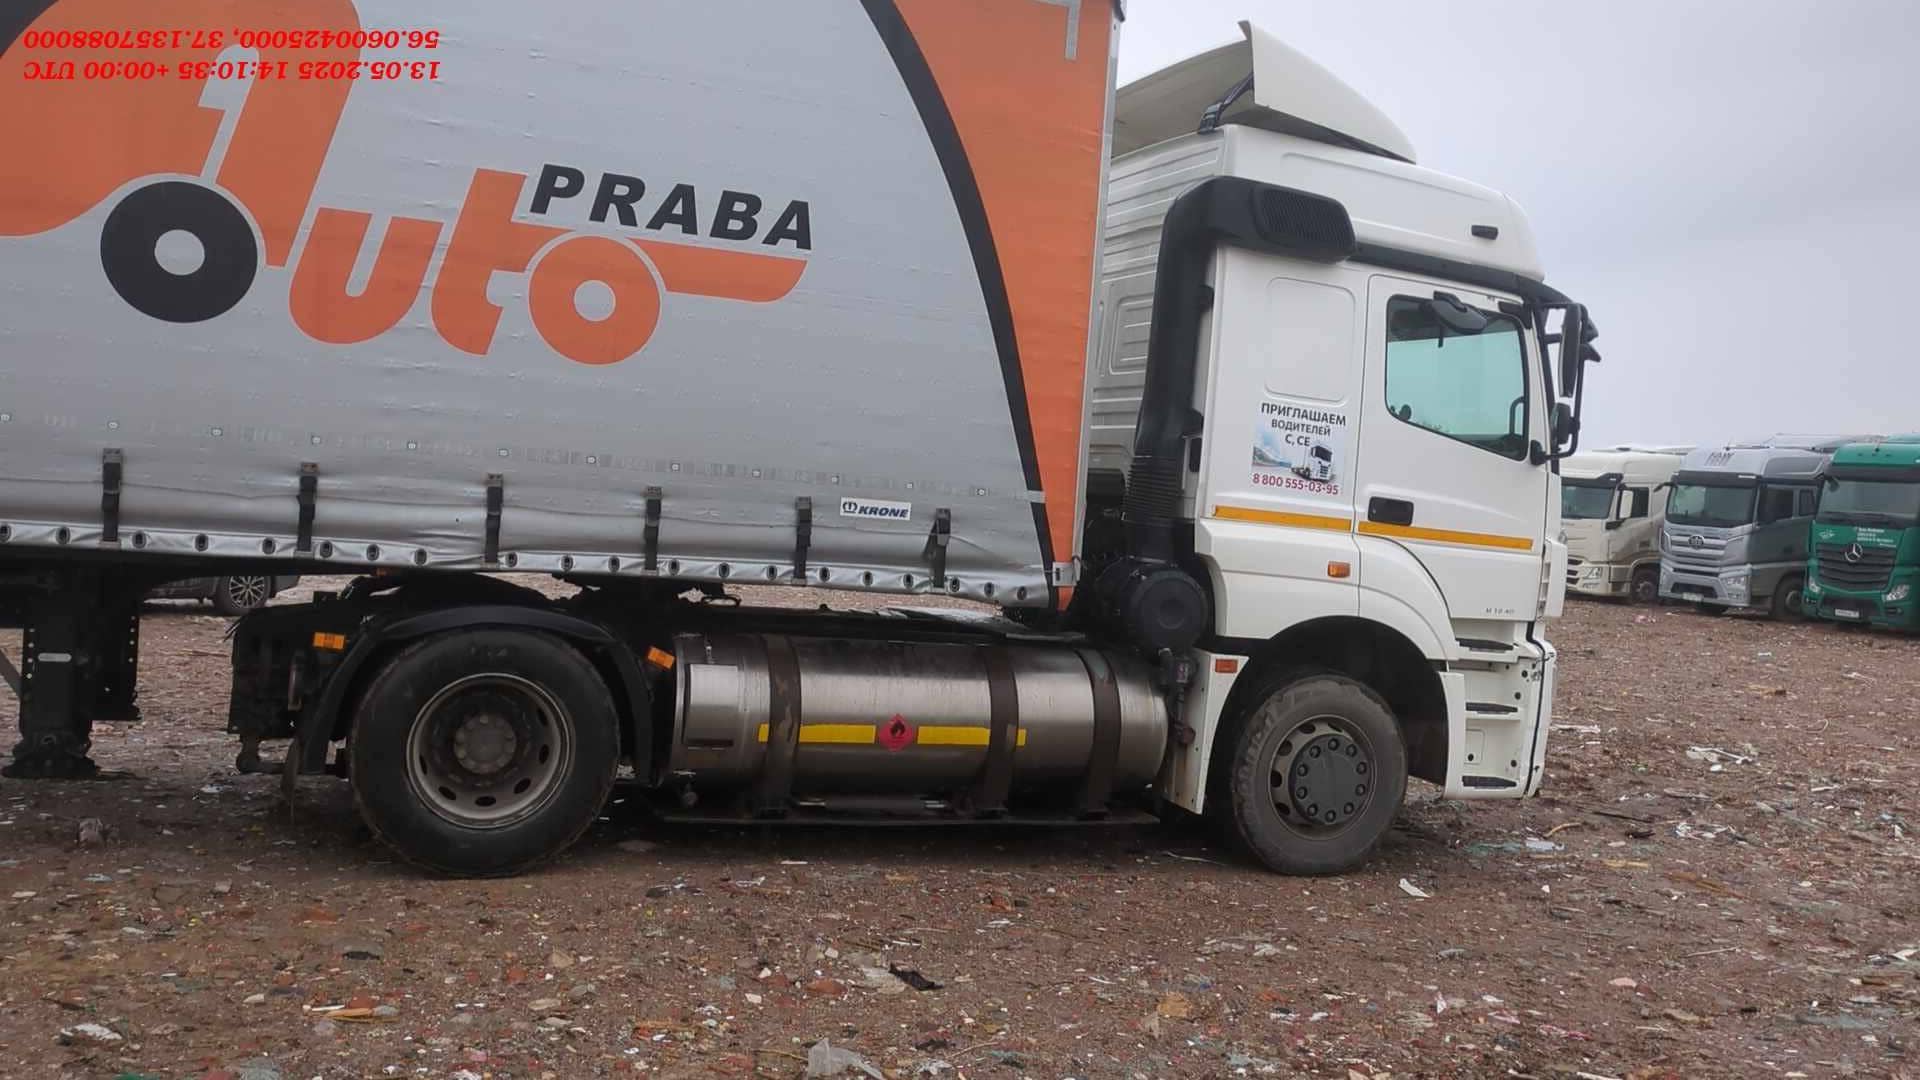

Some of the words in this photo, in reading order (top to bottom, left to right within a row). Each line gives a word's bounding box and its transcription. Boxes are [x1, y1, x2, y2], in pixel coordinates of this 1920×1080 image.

[529, 163, 812, 251] PRABA
[1261, 402, 1346, 426] ПРИГЛАШАЕМ
[1271, 418, 1331, 436] ВОДИТЕЛЕЙ
[1252, 473, 1260, 484] 8
[1262, 474, 1283, 487] 800
[1285, 477, 1339, 495] 555-03-95
[858, 505, 909, 518] KRONE
